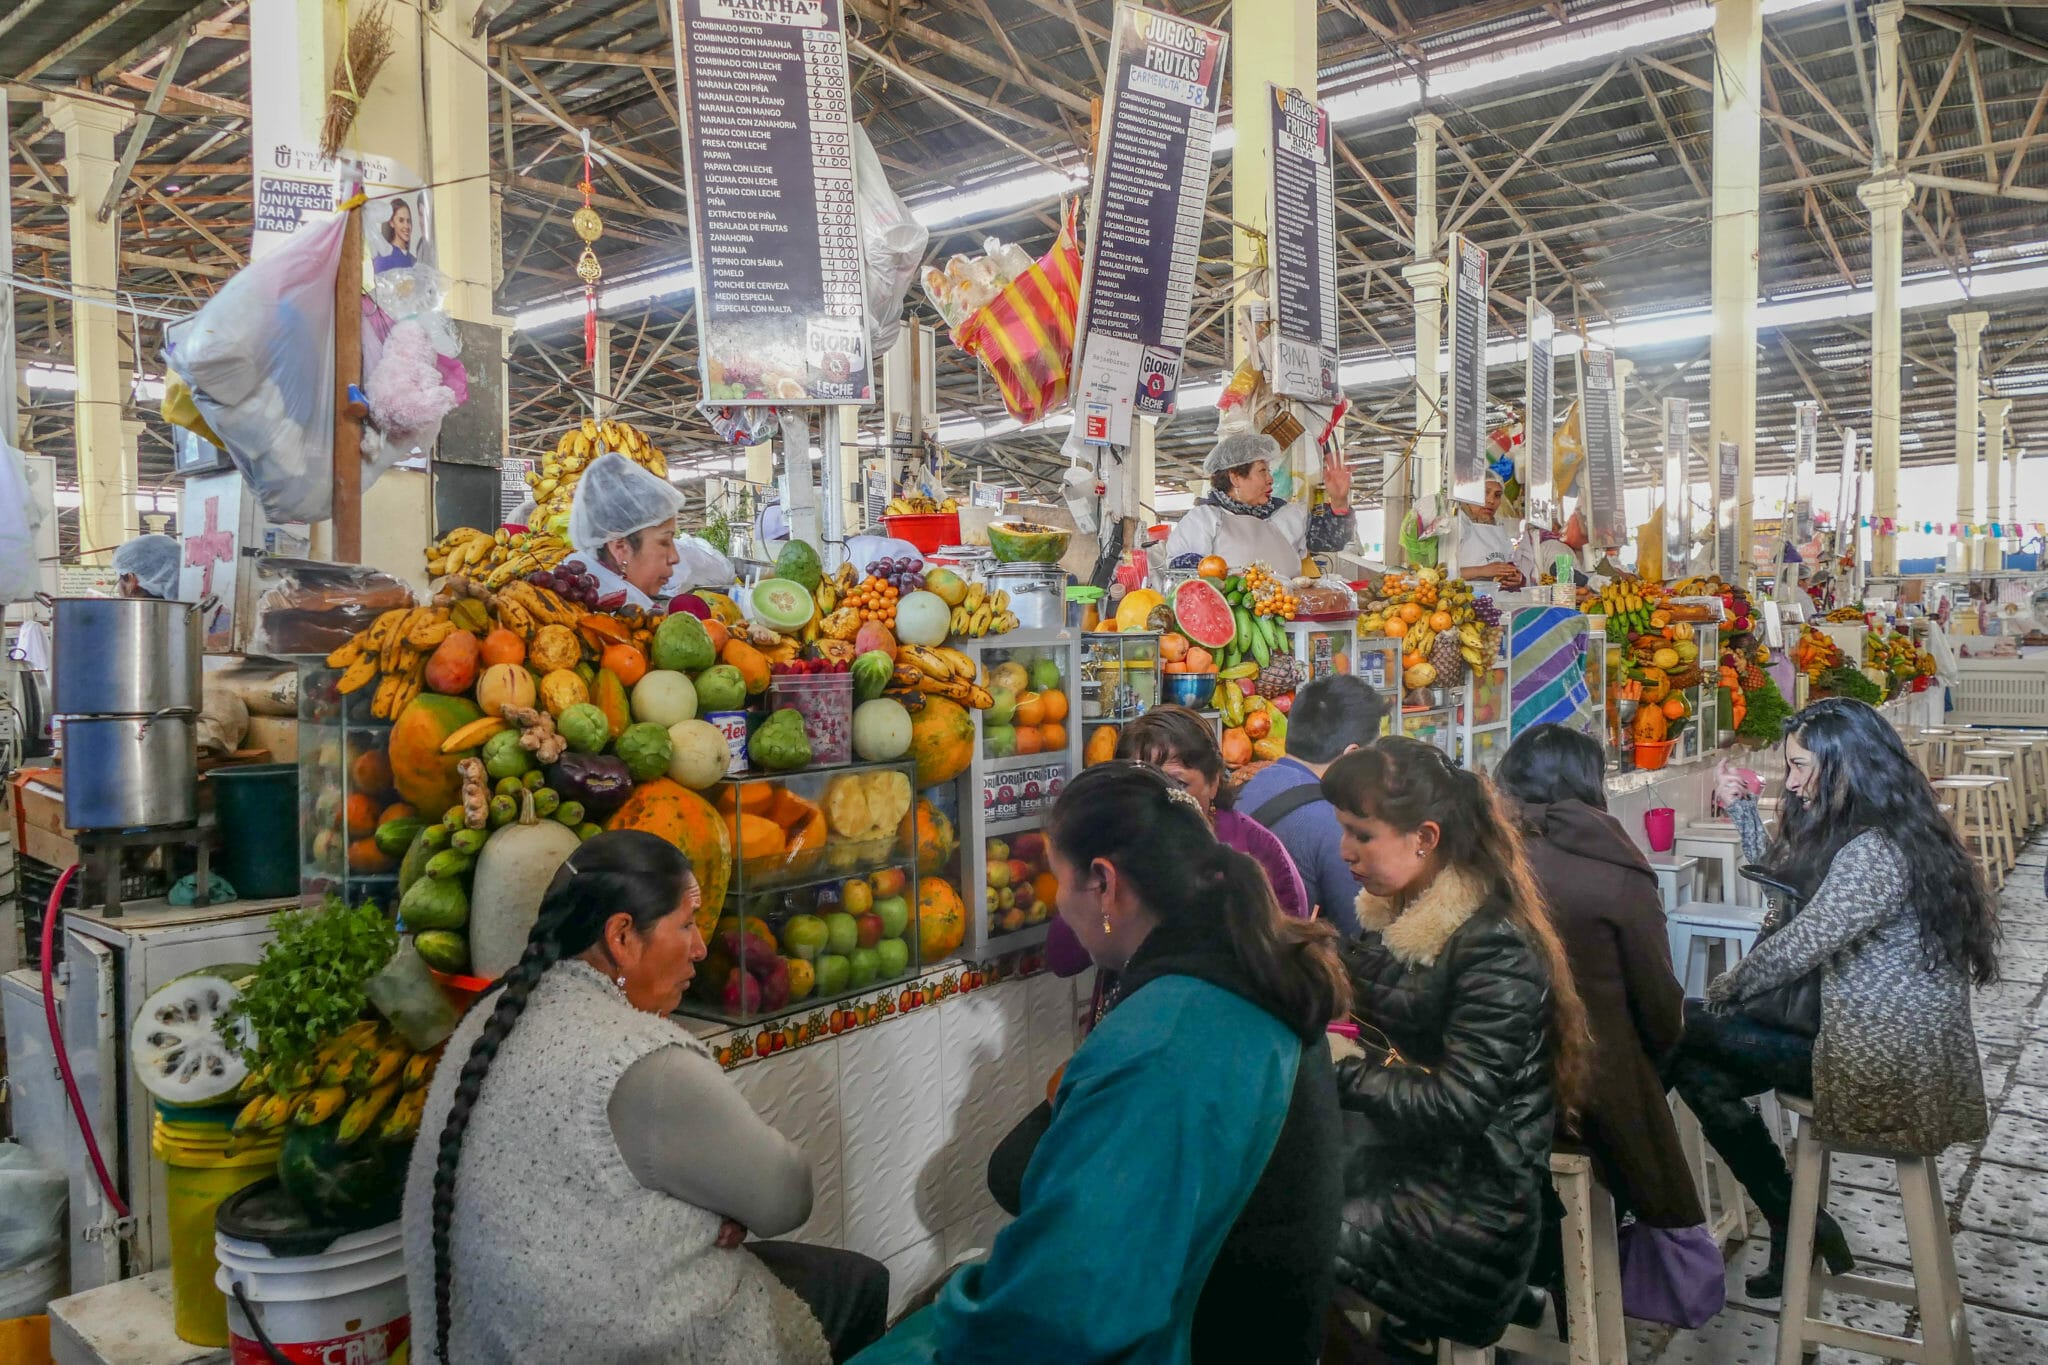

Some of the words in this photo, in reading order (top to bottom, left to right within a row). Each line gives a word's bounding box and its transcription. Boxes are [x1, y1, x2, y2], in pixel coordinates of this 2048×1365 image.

[731, 9, 763, 21] PSTO:
[780, 16, 791, 24] 57
[692, 21, 738, 32] COMBINADO
[739, 25, 763, 34] MIXTO
[693, 33, 739, 44] COMBINADO
[740, 37, 756, 45] CON
[757, 39, 792, 48] NARANJA
[1146, 15, 1195, 51] JUGOS
[1194, 39, 1206, 56] DE
[694, 45, 740, 56] COMBINADO
[741, 49, 757, 57] CON
[758, 50, 801, 61] ZANAHORIA
[695, 56, 741, 67] COMBINADO
[742, 60, 758, 69] CON
[759, 62, 782, 71] LECHE
[1145, 44, 1200, 81] FRUTAS
[696, 68, 732, 78] NARANJA
[732, 71, 749, 79] CON
[750, 73, 777, 82] PAPAYA
[697, 80, 733, 90] NARANJA
[733, 83, 750, 91] CON
[750, 82, 769, 92] PIÑA
[698, 92, 734, 102] NARANJA
[734, 95, 751, 103] CON
[751, 94, 785, 106] PLÁTANO
[1187, 85, 1204, 105] 58
[699, 104, 735, 113] NARANJA
[735, 106, 752, 114] CON
[753, 108, 781, 117] MANGO
[1284, 93, 1312, 121] JUGOS
[700, 115, 736, 125] NARANJA
[736, 118, 753, 126] CON
[753, 119, 797, 129] ZANAHORIA
[701, 127, 730, 136] MANGO
[731, 129, 747, 137] CON
[748, 130, 771, 139] LECHE
[1286, 115, 1318, 144] FRUTAS
[702, 139, 726, 147] FRESA
[726, 140, 743, 149] CON
[744, 142, 767, 150] LECHE
[703, 151, 731, 160] PAPAYA
[704, 162, 732, 171] PAPAYA
[732, 164, 749, 172] CON
[750, 165, 773, 174] LECHE
[705, 173, 737, 183] LÚCUMA
[737, 177, 754, 185] CON
[754, 178, 778, 186] LECHE
[262, 179, 334, 197] CARRERAS
[706, 184, 740, 195] PLÁTANO
[740, 188, 757, 196] CON
[758, 189, 781, 198] LECHE
[707, 196, 726, 206] PIÑA
[259, 205, 296, 219] PARA
[708, 209, 747, 219] EXTRACTO
[758, 211, 776, 221] PIÑA
[709, 221, 749, 231] ENSALADA
[749, 223, 760, 231] DE
[760, 224, 788, 233] FRUTAS
[710, 233, 754, 242] ZANAHORIA
[711, 245, 747, 254] NARANJA
[712, 257, 740, 265] PEPINO
[740, 258, 757, 266] CON
[757, 258, 783, 268] SÁBILA
[713, 269, 744, 277] POMELO
[714, 280, 745, 289] PONCHE
[745, 281, 756, 289] DE
[757, 282, 789, 291] CERVEZA
[715, 292, 740, 300] MEDIO
[740, 293, 774, 302] ESPECIAL
[715, 303, 750, 312] ESPECIAL
[751, 305, 767, 313] CON
[768, 306, 792, 314] MALTA
[810, 331, 862, 357] GLORIA
[1279, 342, 1310, 373] RINA
[1143, 356, 1176, 379] GLORIA
[817, 380, 854, 396] LECHE
[1141, 394, 1164, 410] LECHE
